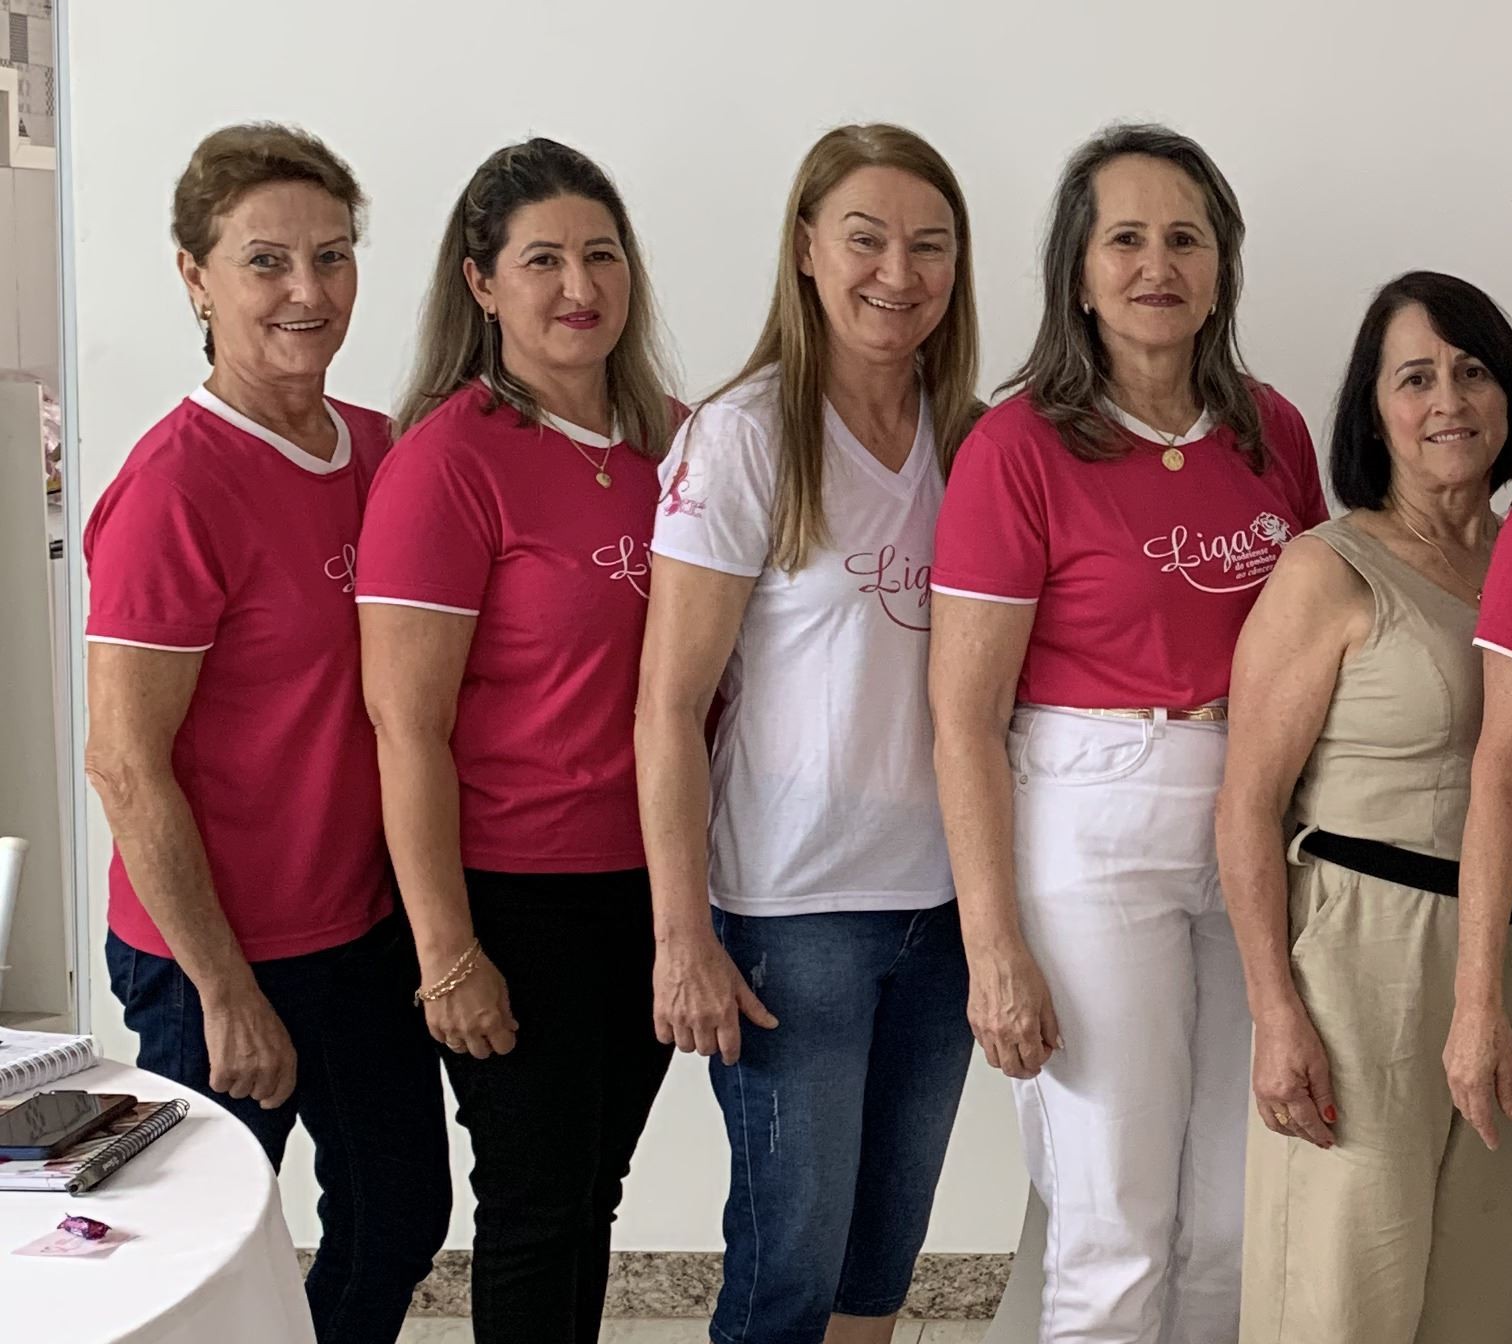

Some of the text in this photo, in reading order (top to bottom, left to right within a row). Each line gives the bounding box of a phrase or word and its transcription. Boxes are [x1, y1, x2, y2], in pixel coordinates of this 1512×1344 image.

[592, 535, 652, 580] Li
[1143, 525, 1254, 573] Liga
[844, 544, 931, 609] Lig
